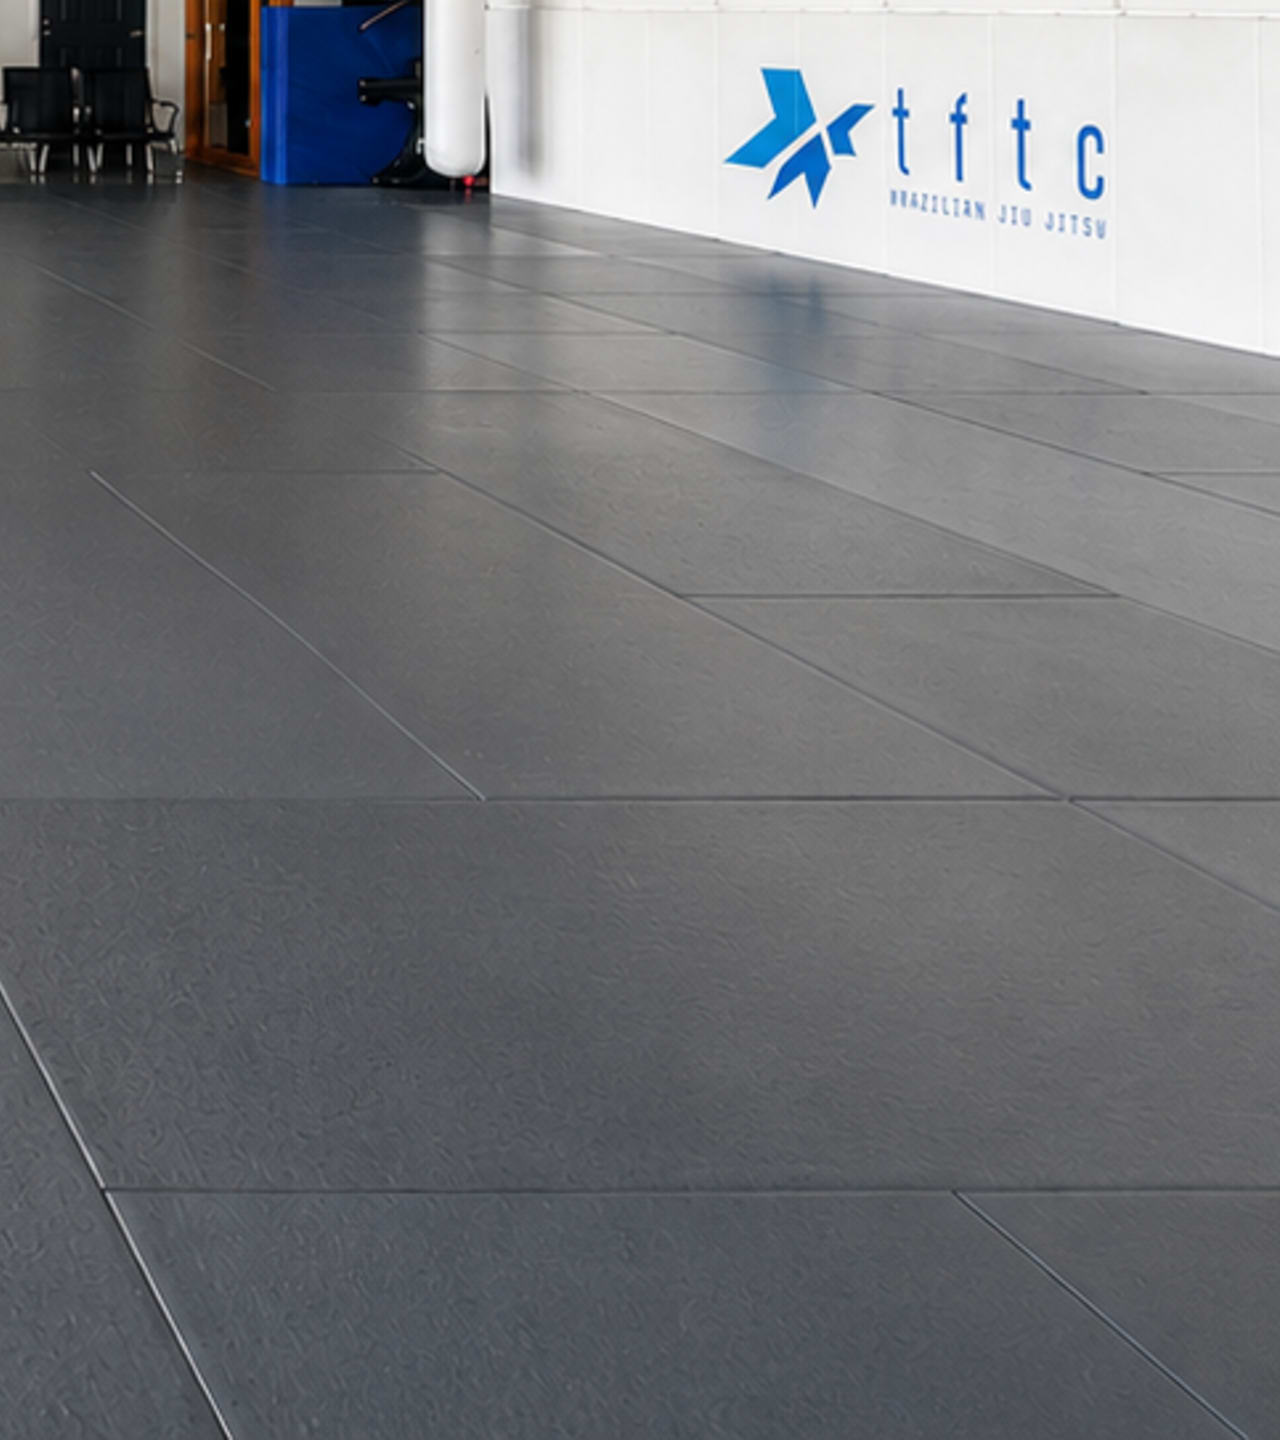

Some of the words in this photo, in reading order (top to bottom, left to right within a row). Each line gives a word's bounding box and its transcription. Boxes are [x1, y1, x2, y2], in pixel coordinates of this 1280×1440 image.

[892, 87, 1105, 201] tftc
[890, 188, 986, 222] BRAZILIAN
[996, 204, 1033, 228] JIU
[1044, 211, 1107, 240] JITSU
